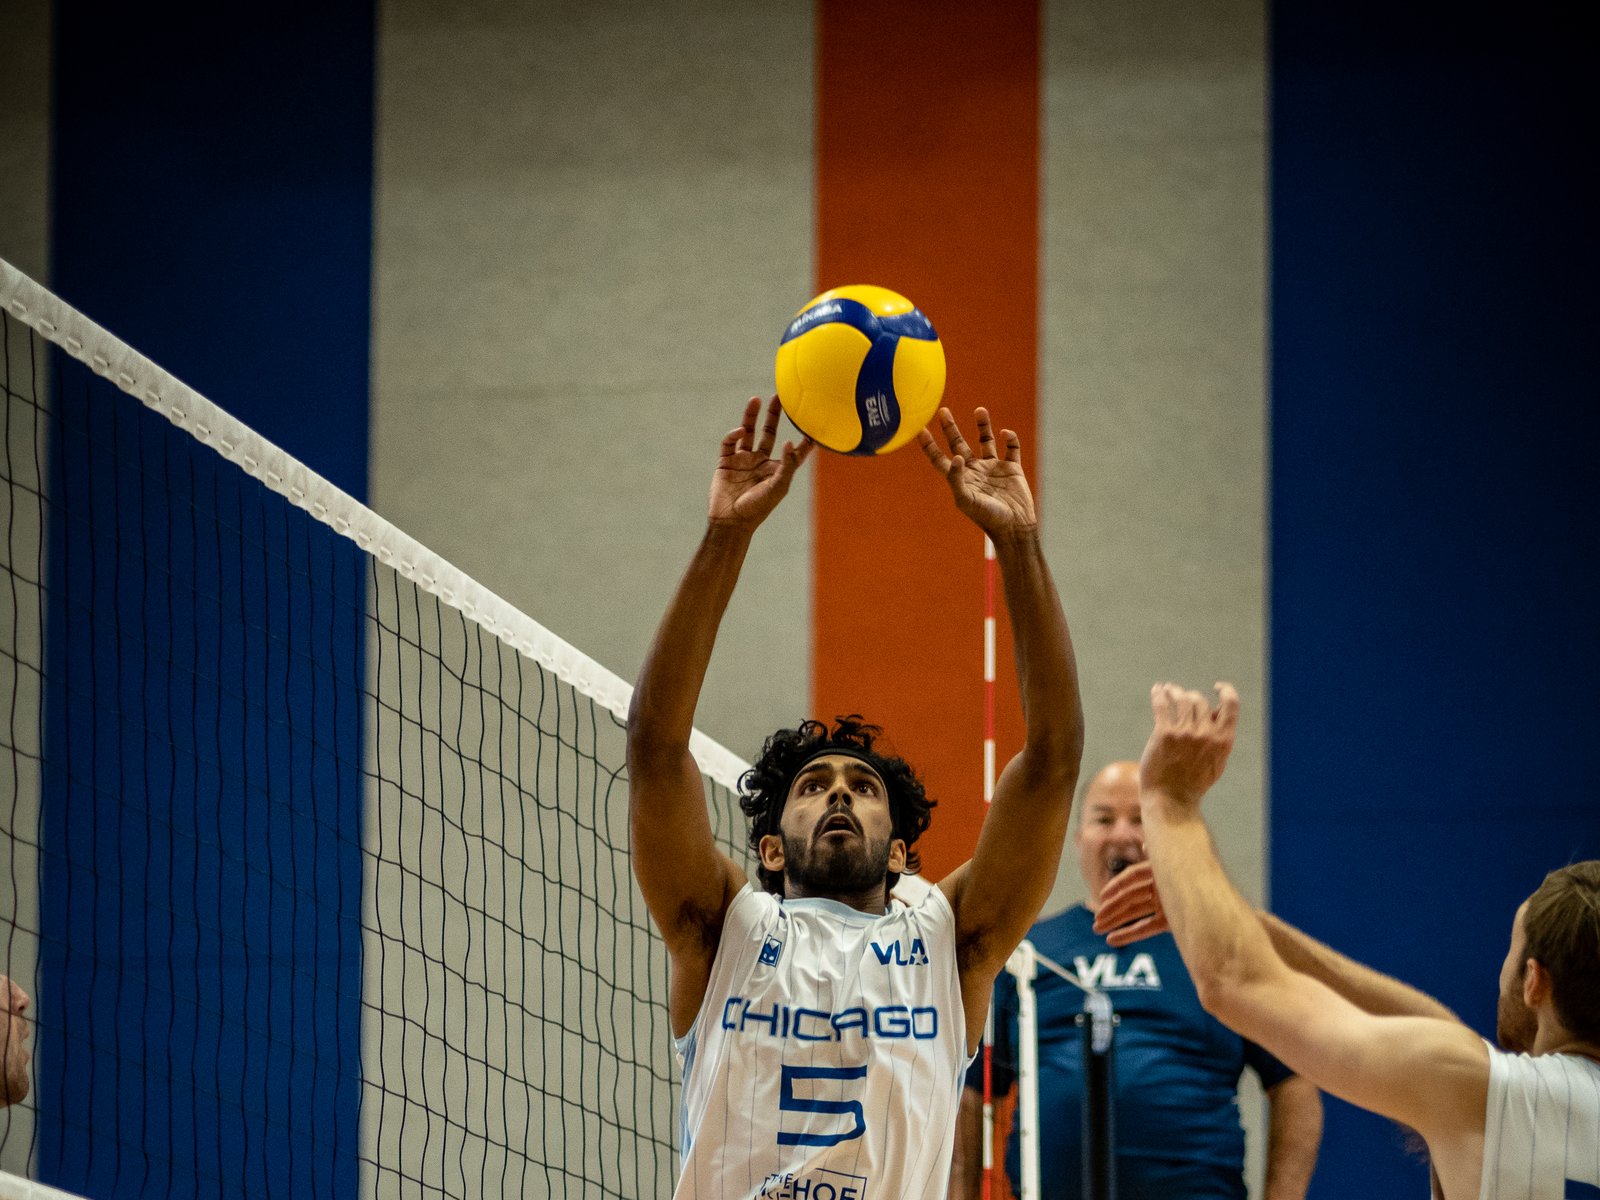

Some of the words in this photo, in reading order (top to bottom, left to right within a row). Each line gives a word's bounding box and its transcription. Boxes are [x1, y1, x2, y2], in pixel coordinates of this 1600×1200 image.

[870, 938, 929, 966] VLA
[1073, 952, 1161, 988] VLA
[721, 997, 938, 1042] CHICAGO
[776, 1064, 867, 1147] 5
